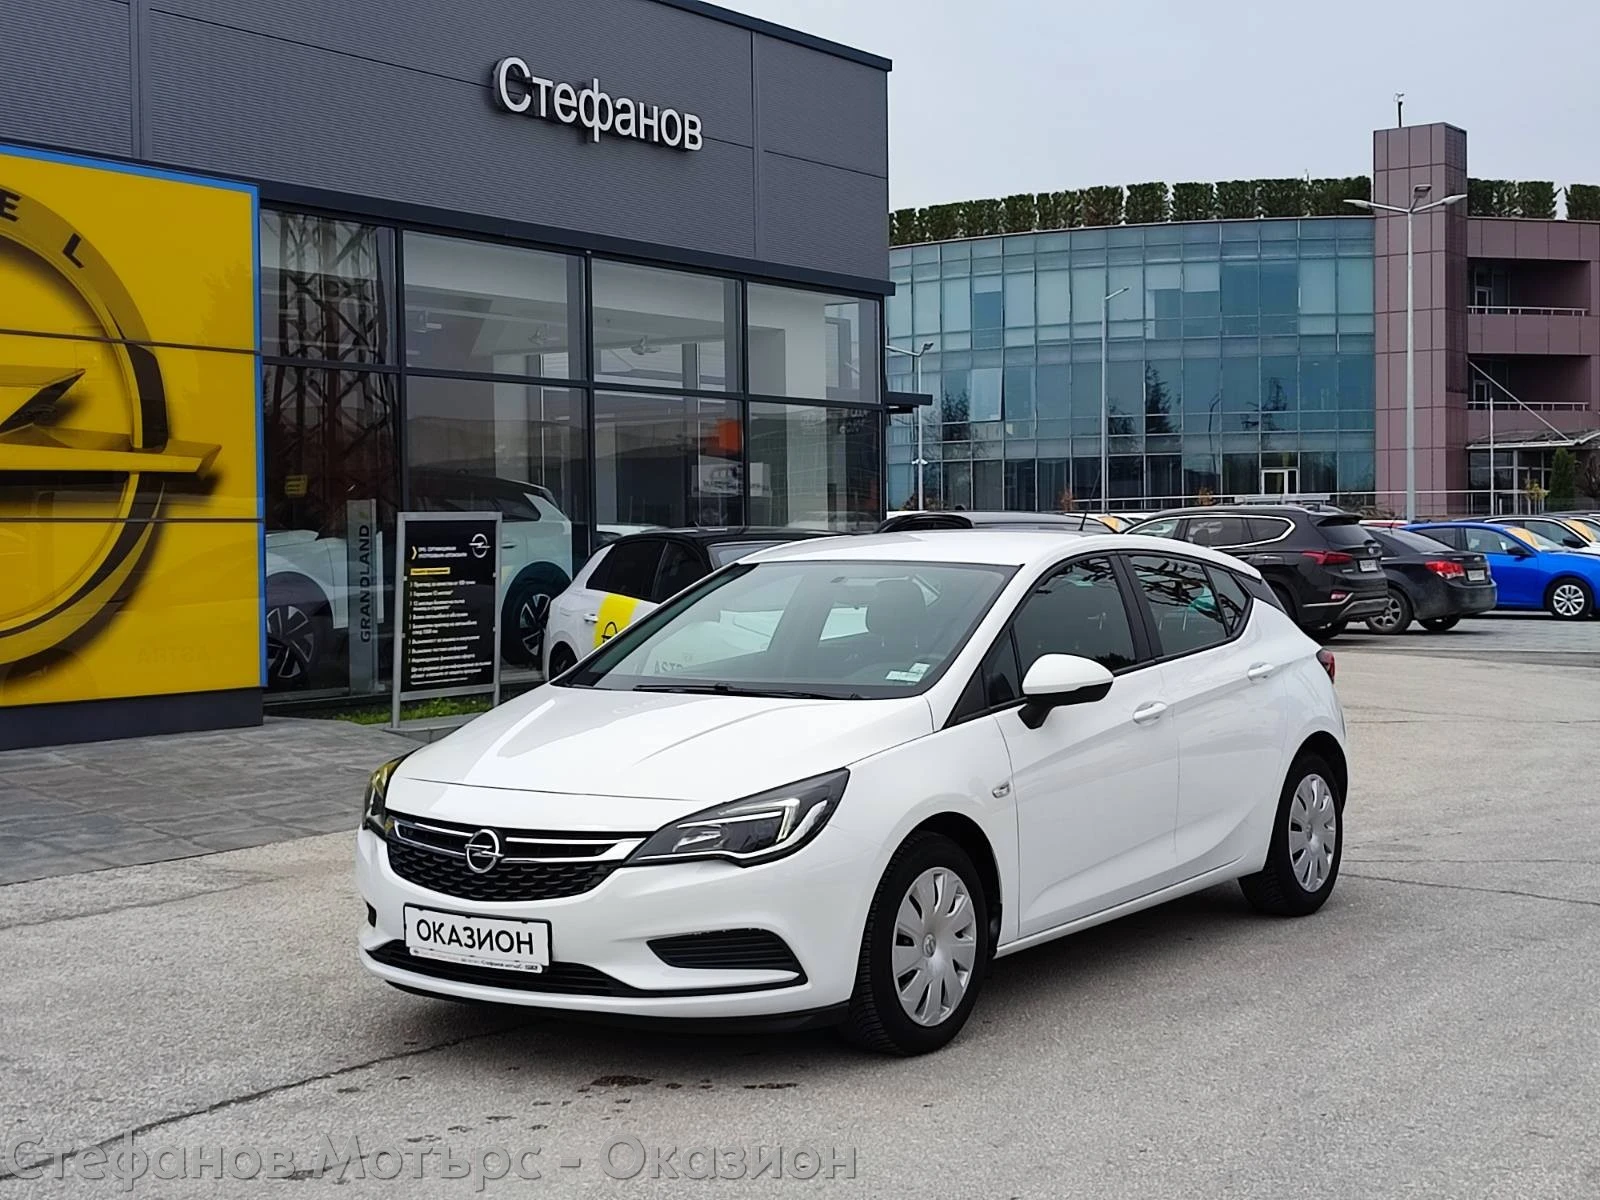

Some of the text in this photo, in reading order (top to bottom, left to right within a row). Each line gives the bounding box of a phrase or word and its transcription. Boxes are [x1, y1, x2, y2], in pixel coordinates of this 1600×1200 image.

[498, 56, 703, 151] Стефанов
[359, 524, 371, 643] GRANDLAND
[416, 918, 534, 955] ОКАЗИОН
